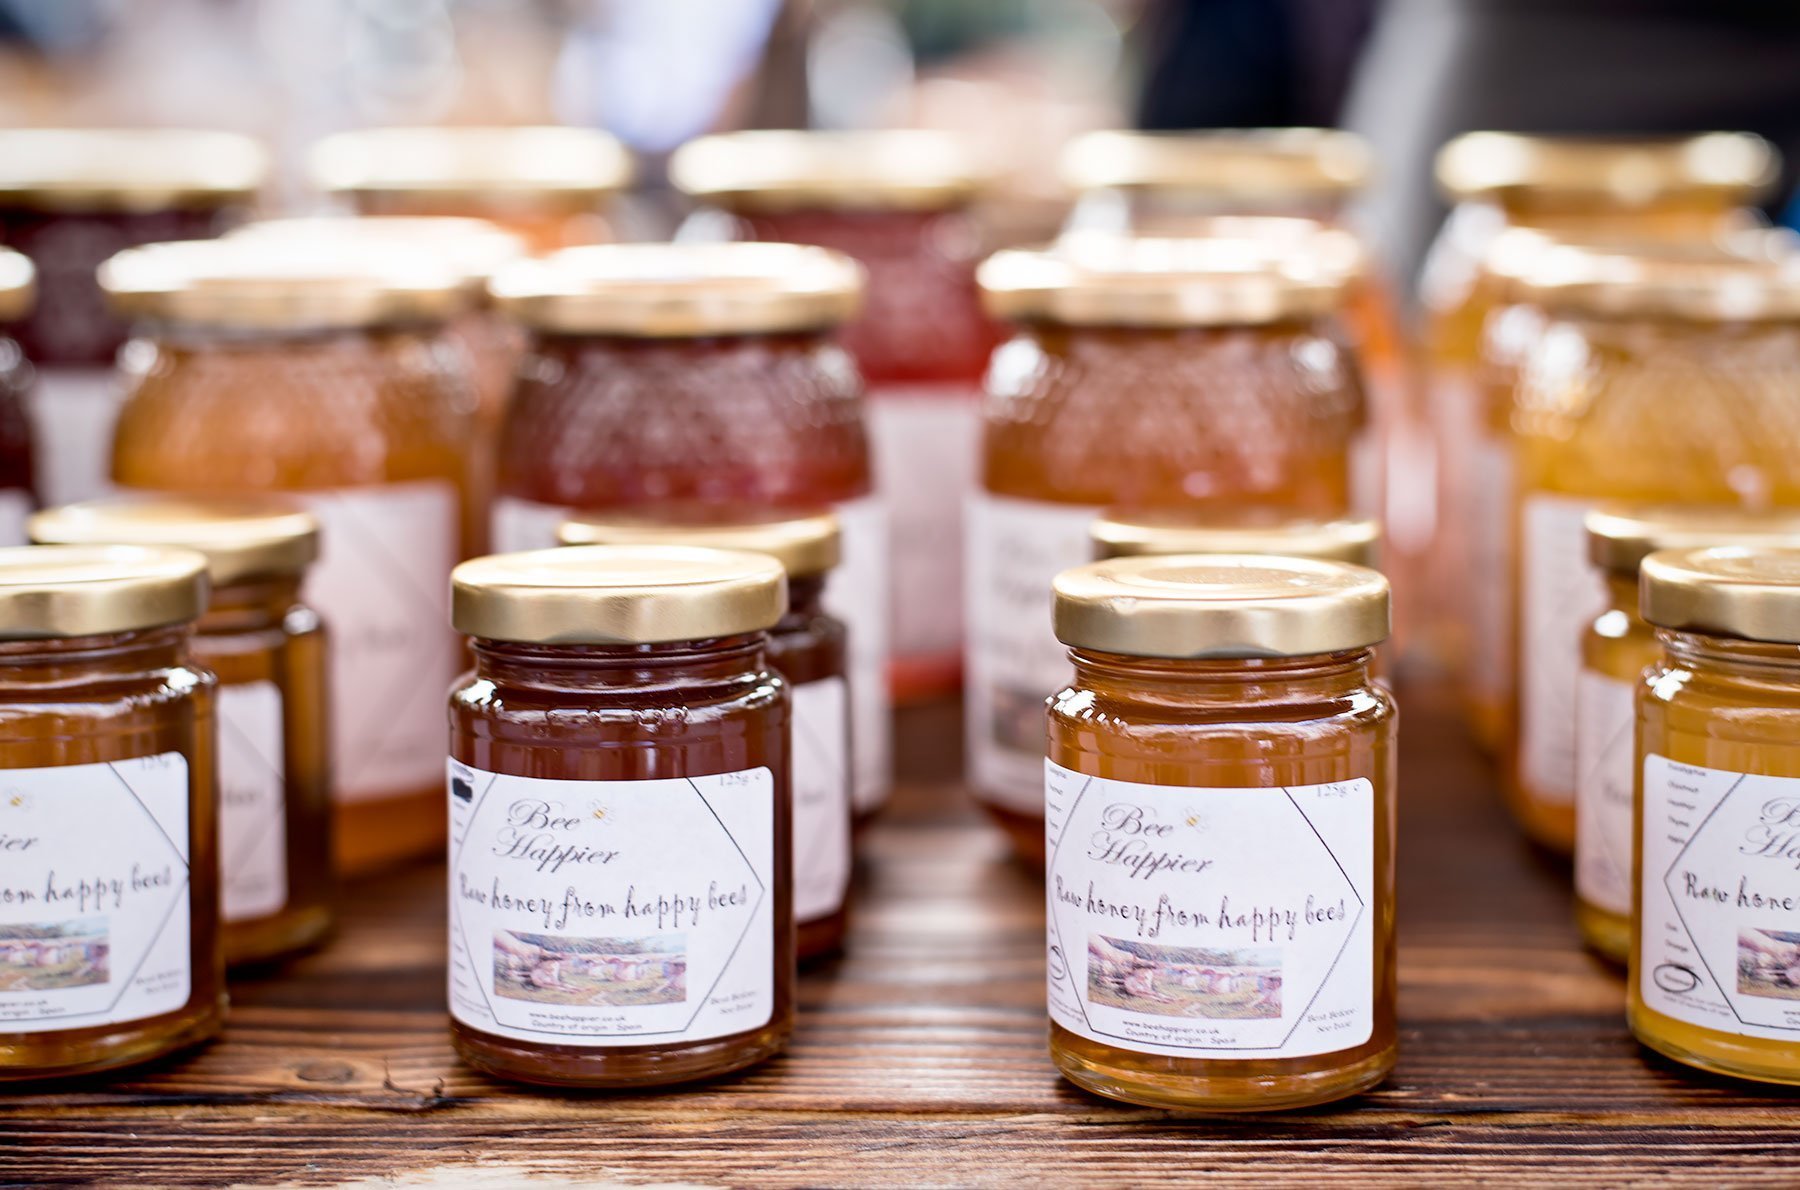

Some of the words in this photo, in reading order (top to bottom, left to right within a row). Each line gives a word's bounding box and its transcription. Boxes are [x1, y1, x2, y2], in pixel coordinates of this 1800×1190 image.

[507, 798, 580, 830] Bee
[1101, 802, 1173, 838] Bee
[492, 827, 620, 873] Happier
[1087, 831, 1214, 879] Happier
[46, 870, 123, 912] happy
[132, 862, 171, 891] bees
[460, 872, 487, 904] Raw
[491, 876, 551, 928] honey
[555, 886, 616, 930] from
[624, 885, 701, 928] happy
[708, 880, 748, 910] bees
[1056, 874, 1082, 907] Raw
[1086, 881, 1147, 936] honey
[1149, 893, 1210, 937] from
[1218, 895, 1297, 941] happy
[1305, 895, 1344, 924] bees
[1684, 870, 1731, 904] Raw
[1738, 875, 1800, 911] hone
[531, 1019, 565, 1030] Country
[617, 1023, 642, 1032] Spain
[1125, 1027, 1158, 1040] Country
[1211, 1036, 1237, 1045] Spain
